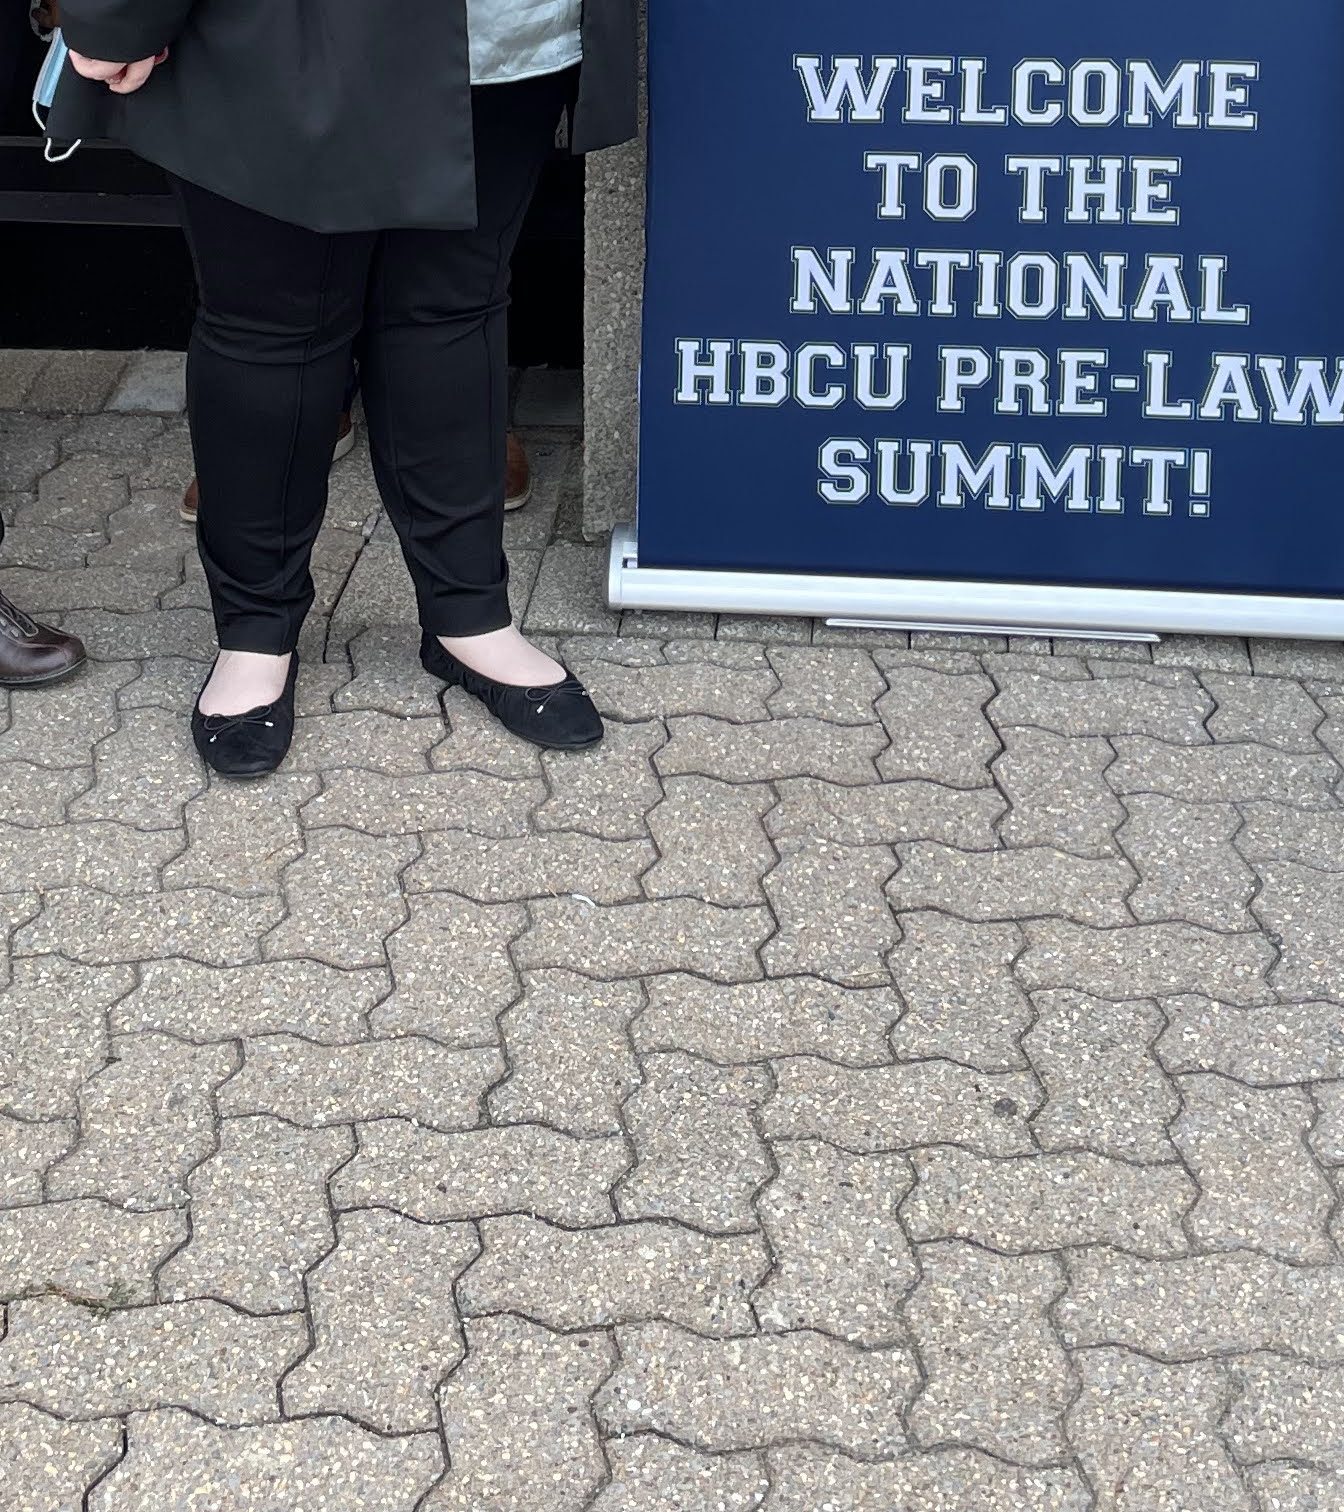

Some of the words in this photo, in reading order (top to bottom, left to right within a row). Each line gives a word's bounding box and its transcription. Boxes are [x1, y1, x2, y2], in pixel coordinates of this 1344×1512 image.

[794, 55, 1258, 129] WELCOME
[864, 152, 977, 221] TO
[1006, 155, 1181, 225] THE
[791, 246, 1249, 325] NATIONAL
[675, 339, 911, 410] HBCU
[817, 437, 1211, 517] SUMMIT!
